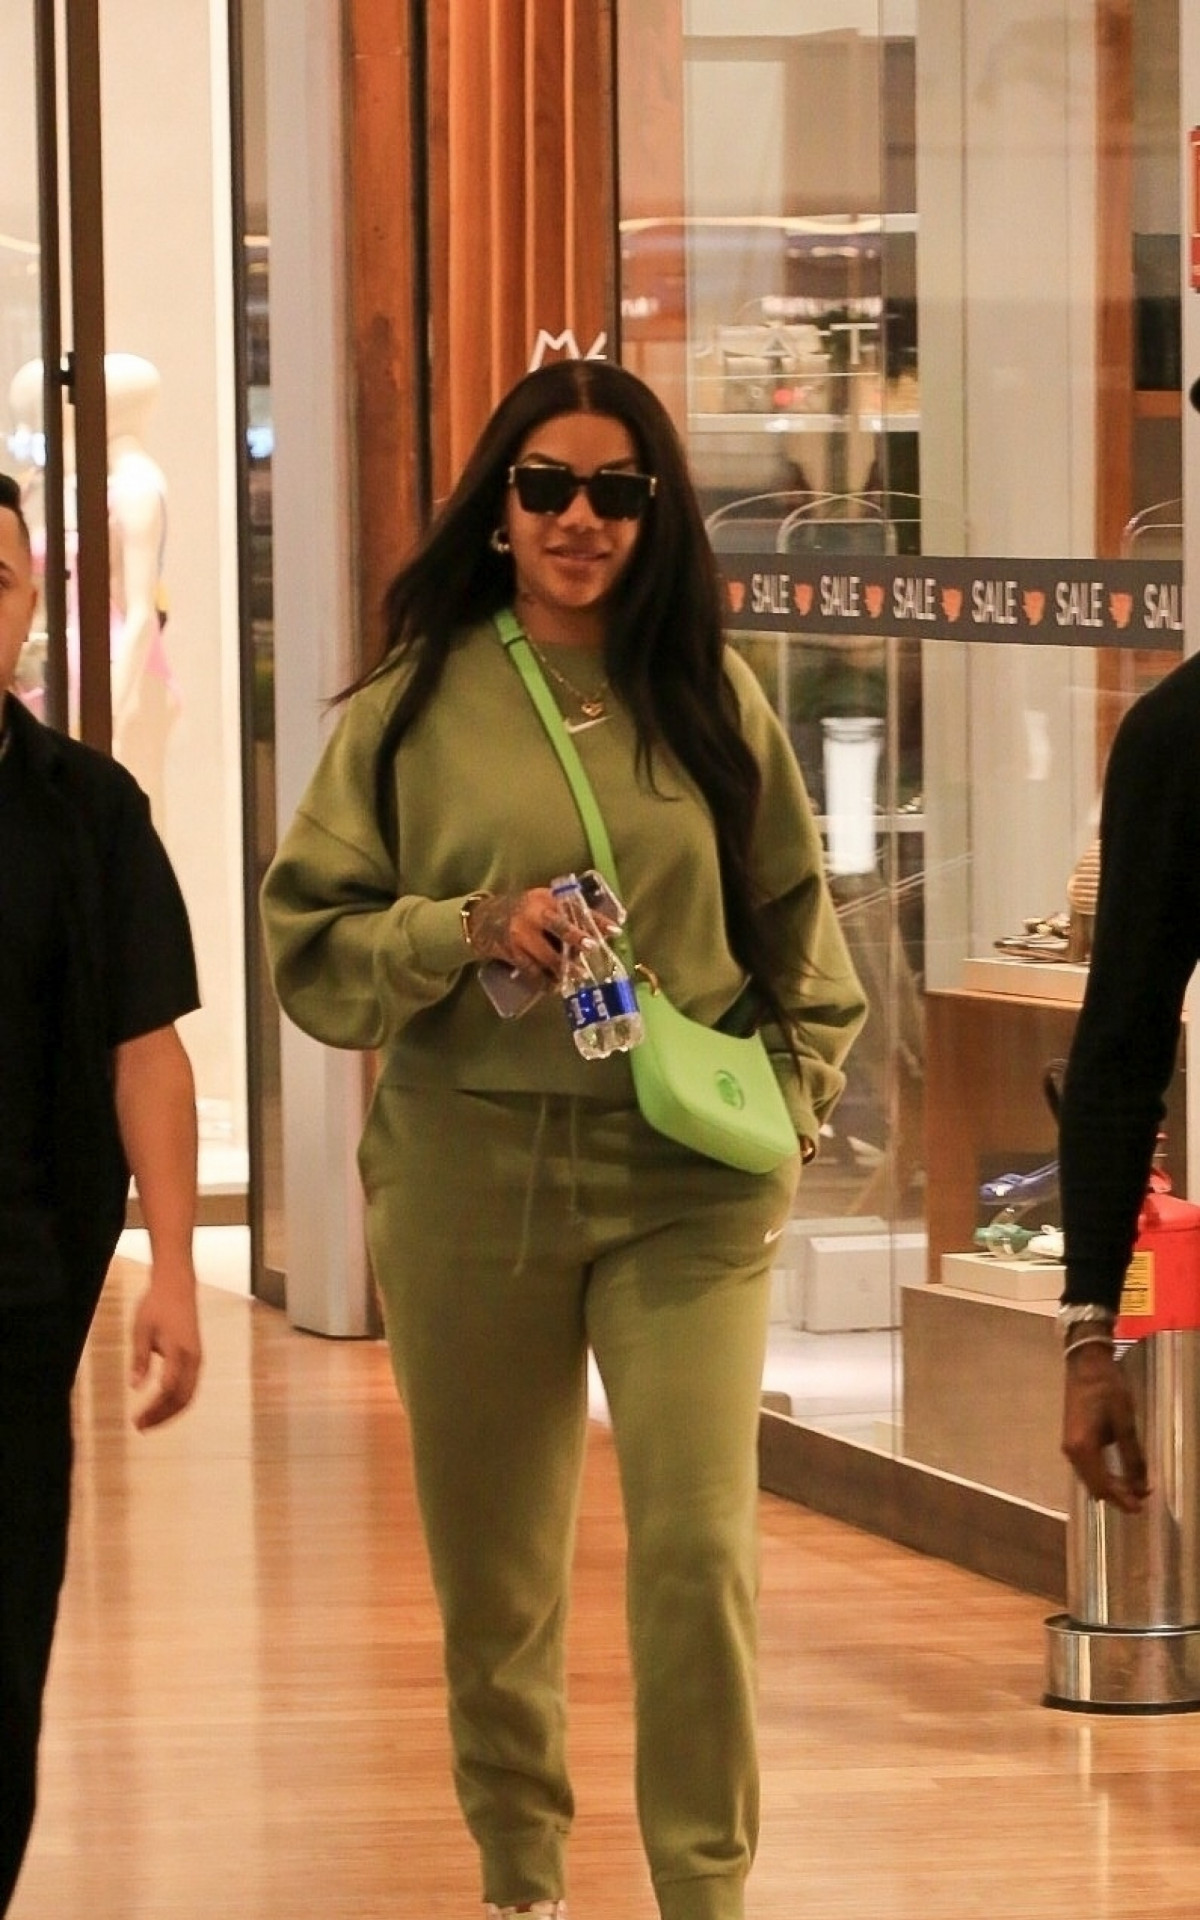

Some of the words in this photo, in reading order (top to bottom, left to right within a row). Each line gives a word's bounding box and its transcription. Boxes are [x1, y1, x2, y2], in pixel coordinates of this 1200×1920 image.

[752, 573, 791, 614] SALE
[820, 575, 861, 616] SALE
[893, 577, 937, 621] SALE
[971, 579, 1018, 624] SALE
[1055, 581, 1104, 627] SALE
[1143, 583, 1184, 630] SAL
